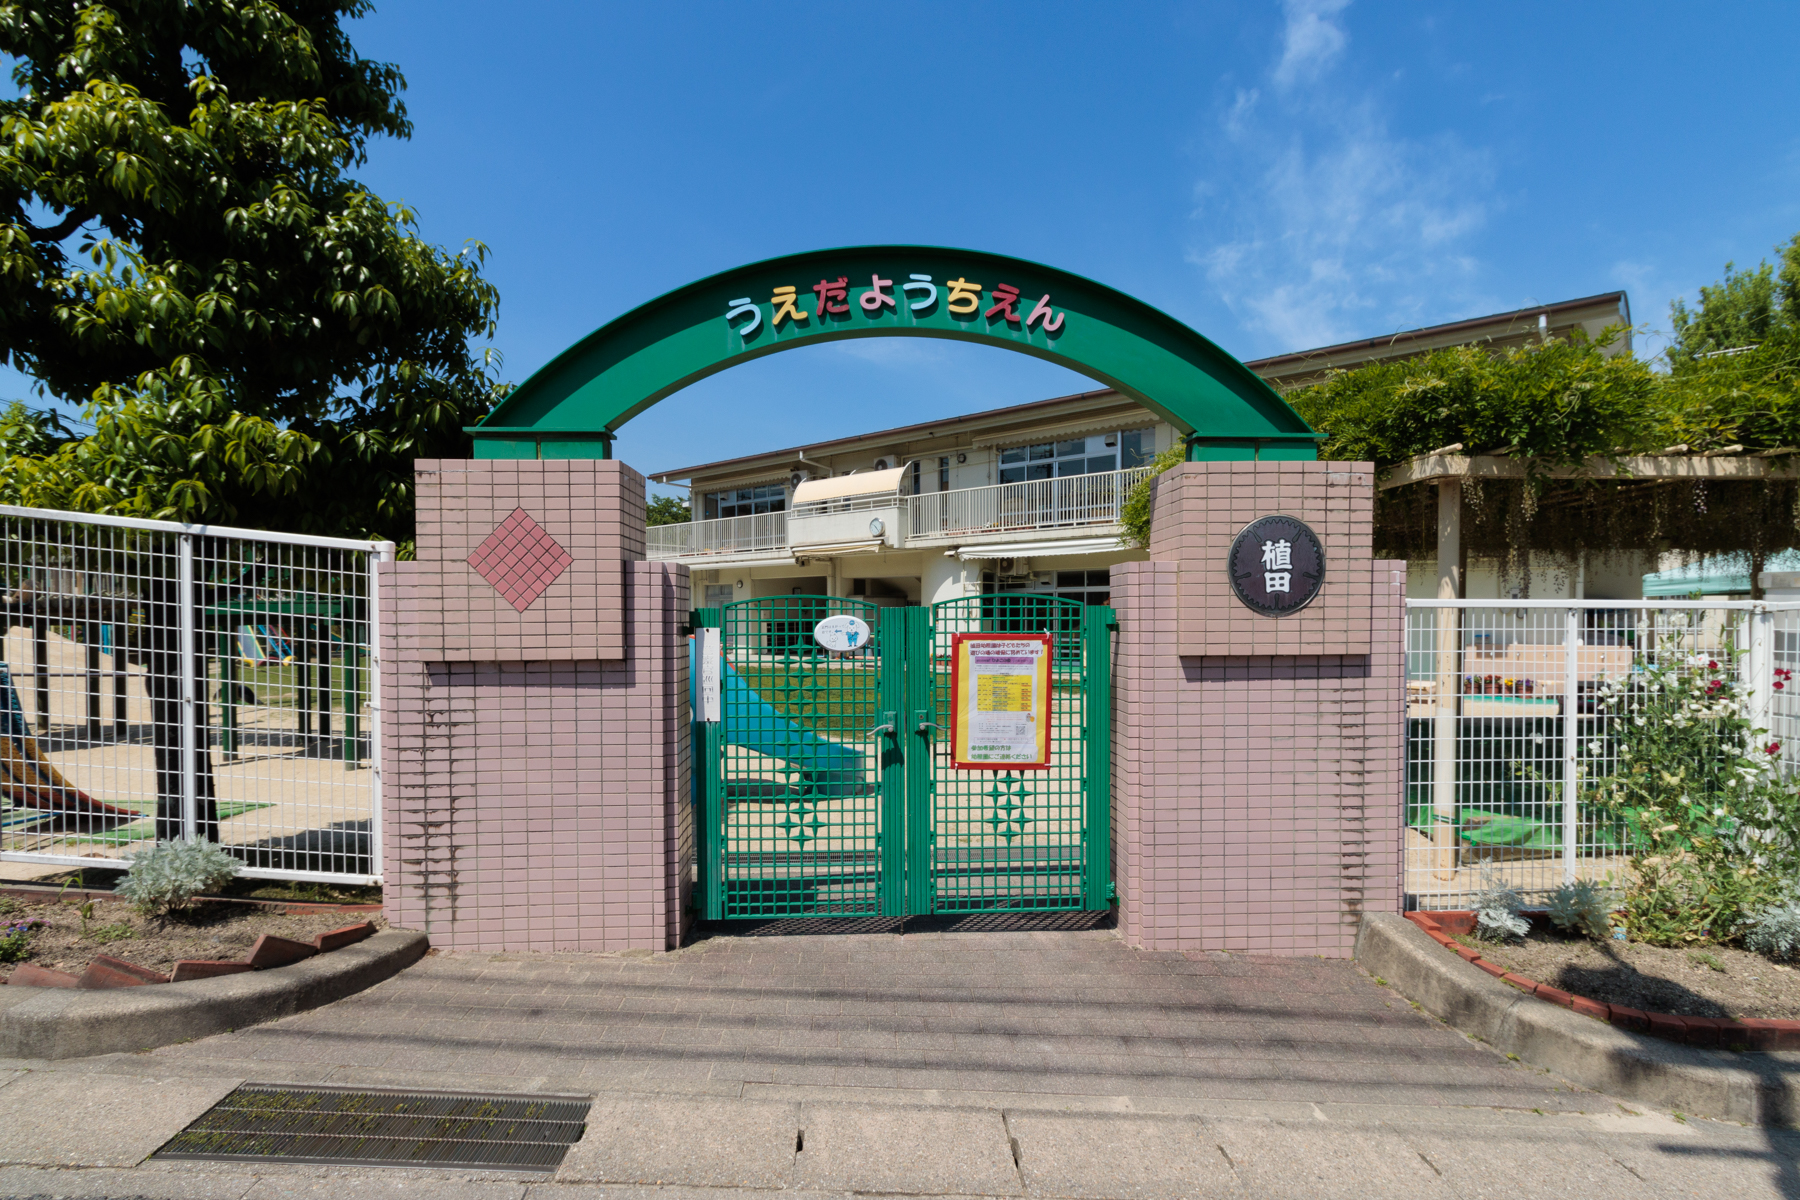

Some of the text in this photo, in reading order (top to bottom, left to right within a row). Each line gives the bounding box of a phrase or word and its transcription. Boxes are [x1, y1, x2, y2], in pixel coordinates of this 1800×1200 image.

[725, 273, 1066, 336] うえだようちえん
[1261, 539, 1293, 593] 植田
